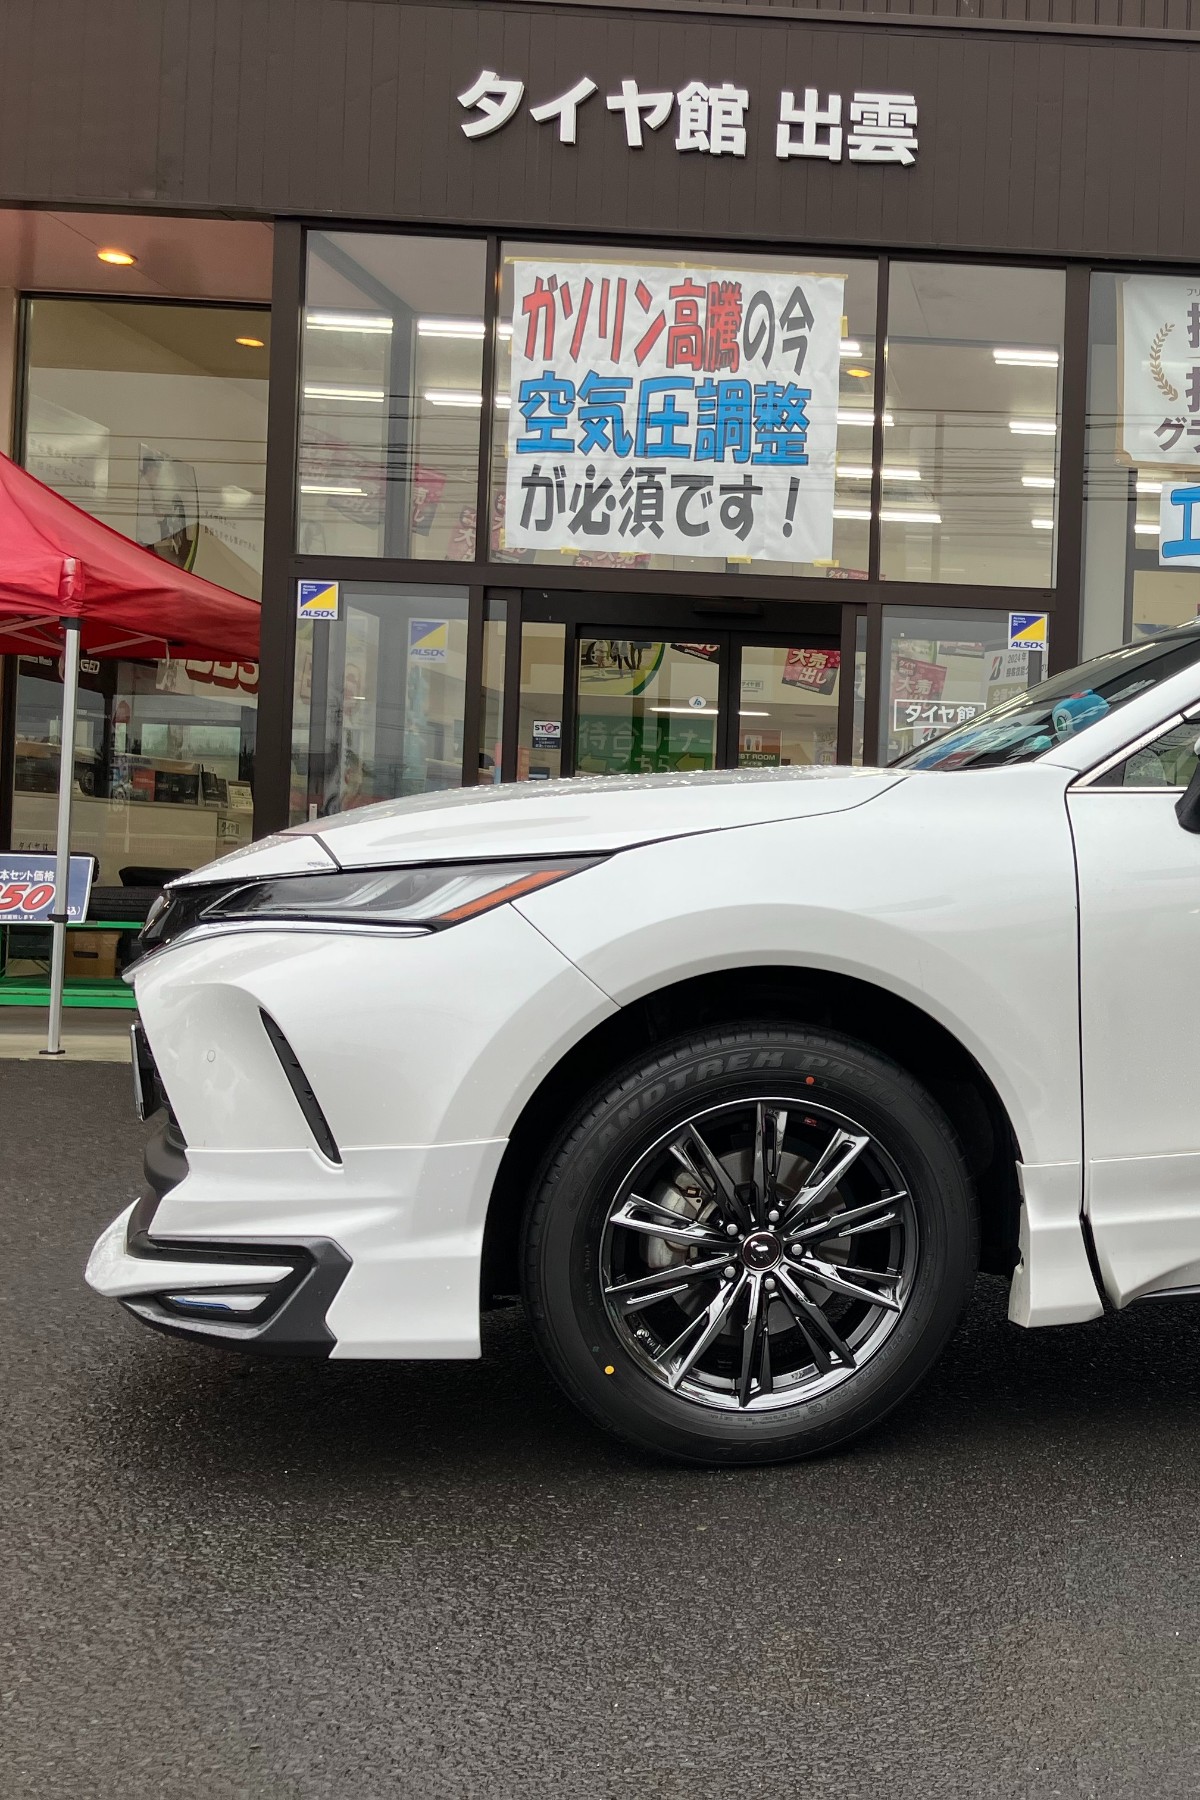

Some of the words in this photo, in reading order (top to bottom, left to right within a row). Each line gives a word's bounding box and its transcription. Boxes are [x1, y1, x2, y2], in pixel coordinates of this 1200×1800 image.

[457, 70, 750, 157] タイヤ館
[776, 88, 919, 166] 出雲
[521, 273, 815, 376] ガソリン高騰の今
[516, 370, 812, 466] 空気圧調整
[519, 463, 800, 541] が必須です！
[300, 609, 335, 618] ALSOK
[410, 648, 446, 657] ALSOK
[1010, 641, 1045, 650] ALSOK
[788, 648, 829, 670] 大売
[798, 667, 828, 684] 出し
[905, 705, 976, 725] タイヤ館
[578, 720, 712, 752] 待合コーナー
[609, 752, 672, 773] こちら
[0, 869, 55, 882] 本セット価格
[0, 883, 55, 911] 50
